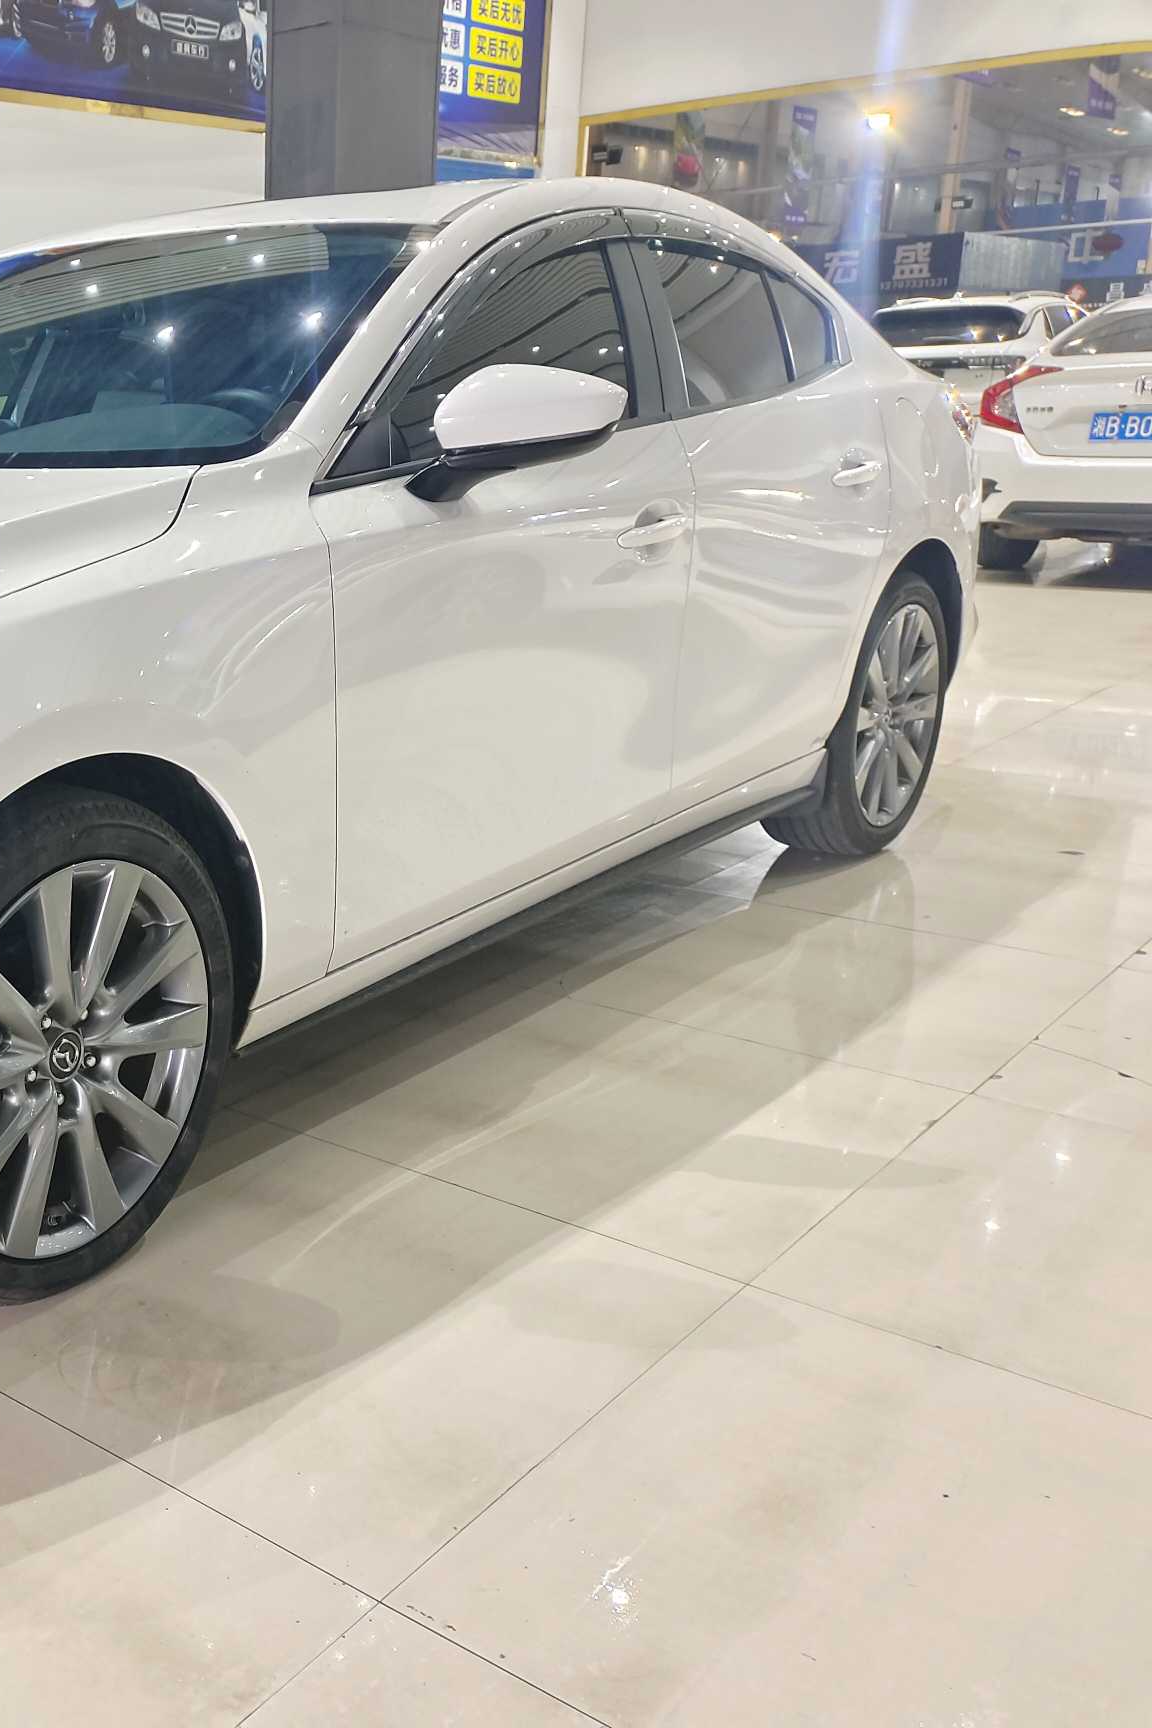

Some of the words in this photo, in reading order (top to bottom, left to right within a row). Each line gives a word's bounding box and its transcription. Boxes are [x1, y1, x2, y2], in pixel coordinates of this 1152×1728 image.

[476, 35, 520, 61] 买后开心
[474, 72, 518, 97] 买后放心
